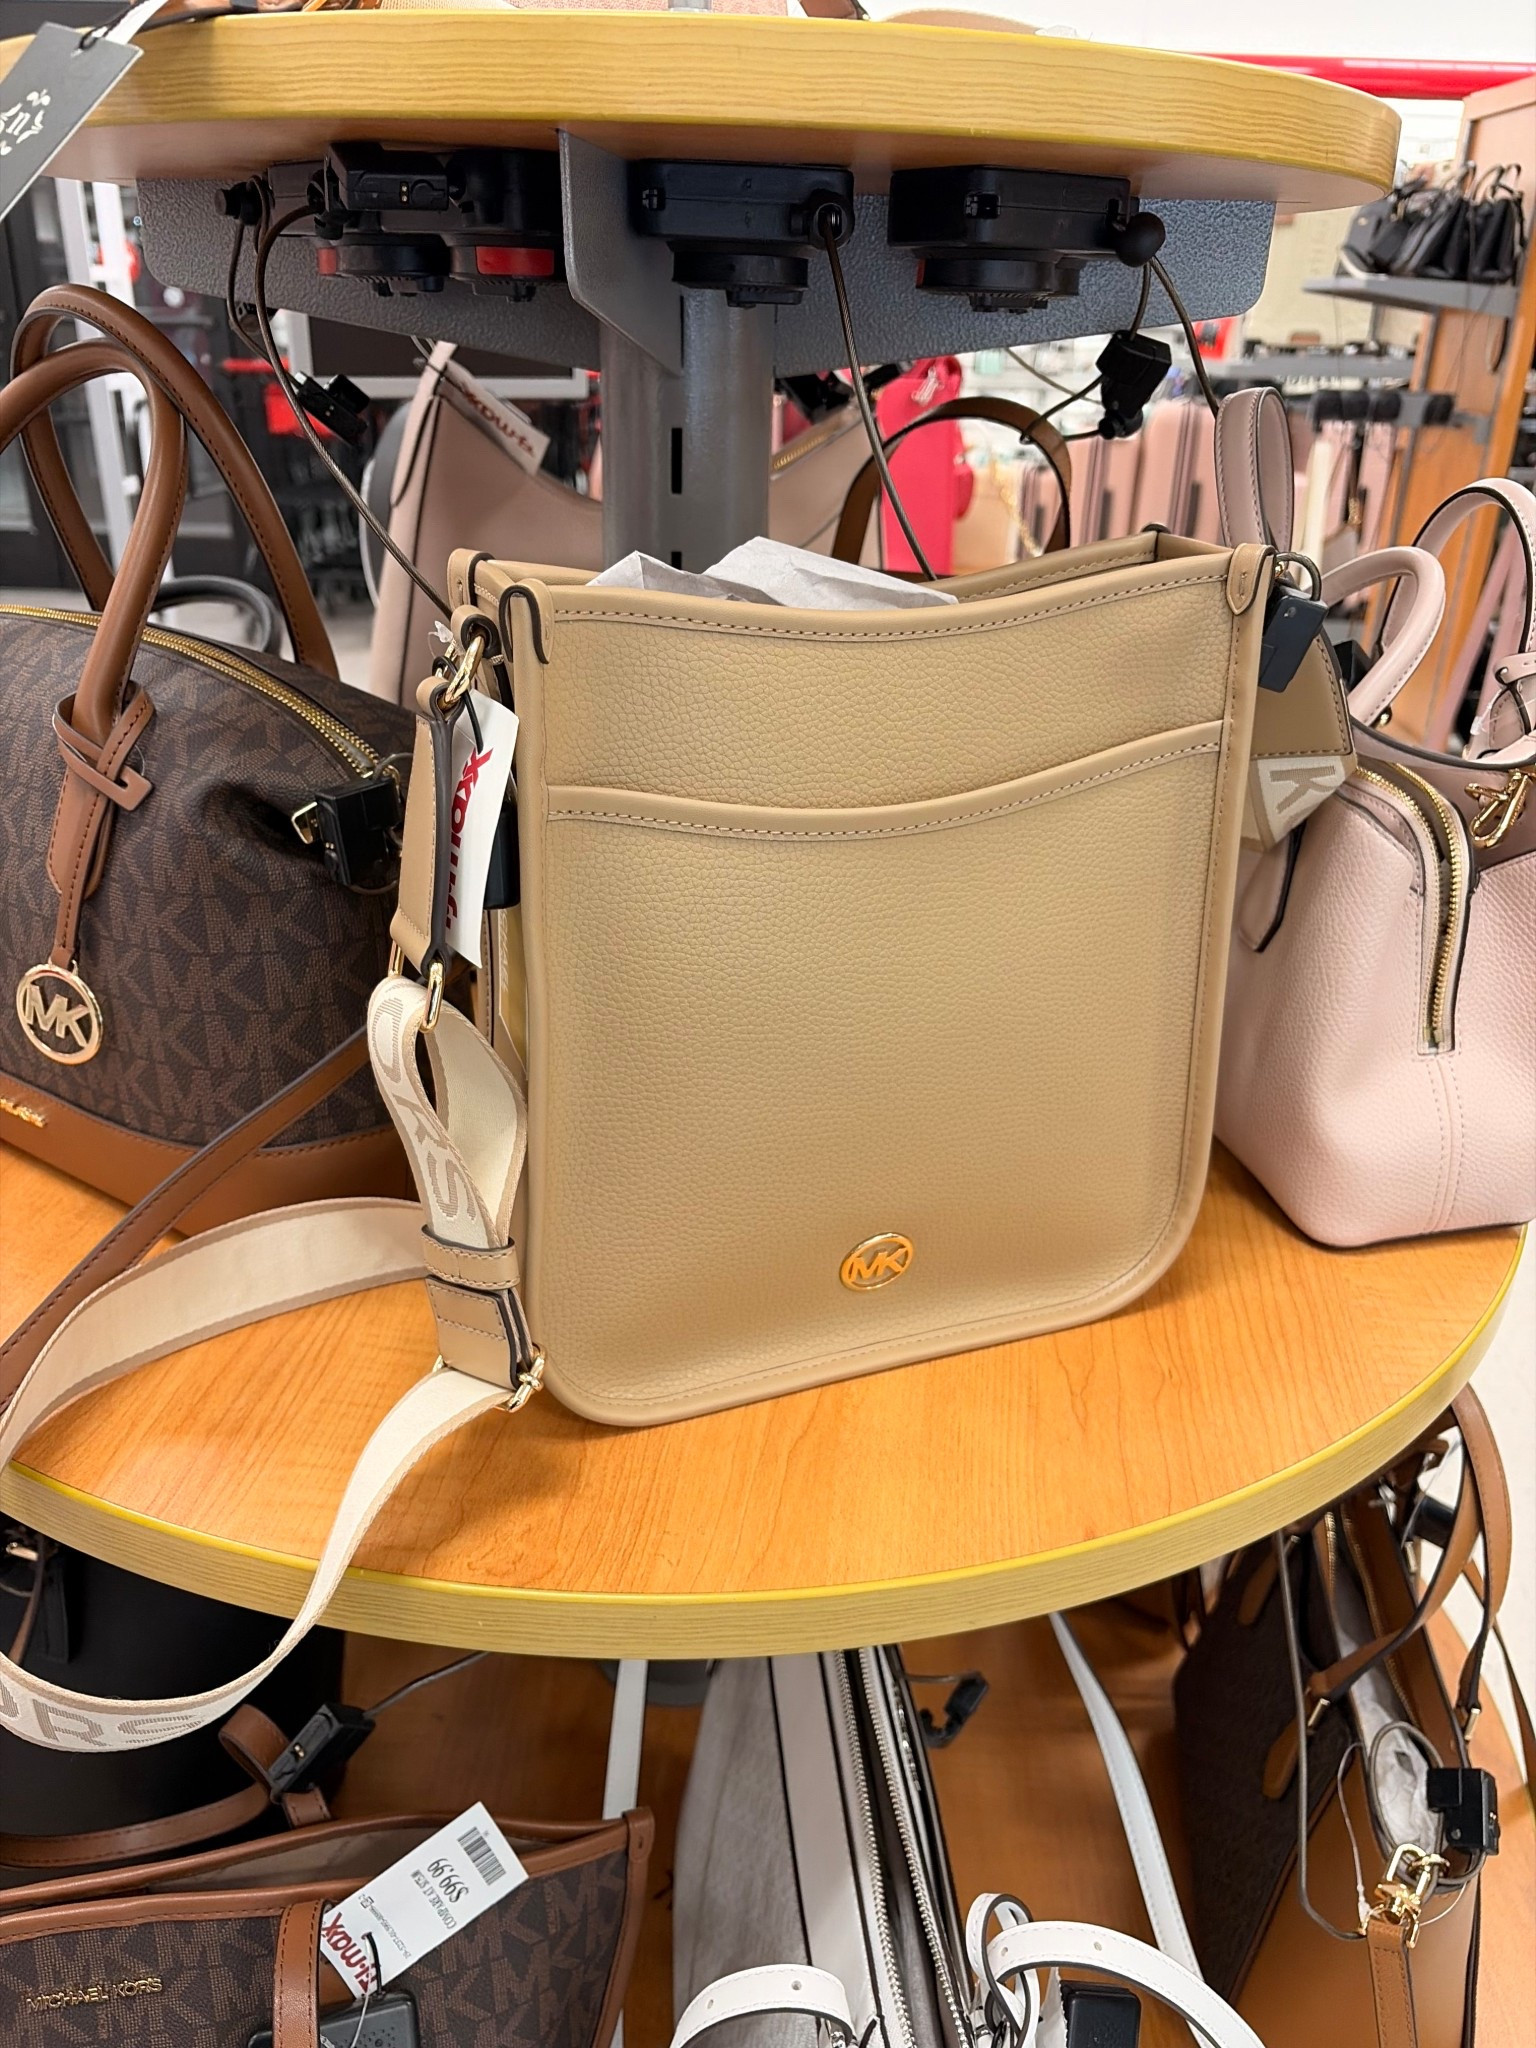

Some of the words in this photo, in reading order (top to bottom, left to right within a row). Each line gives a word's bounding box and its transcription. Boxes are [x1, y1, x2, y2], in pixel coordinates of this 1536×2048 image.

[22, 980, 94, 1050] MK
[846, 1243, 910, 1282] MK
[427, 1858, 469, 1903] $99.99
[26, 1985, 109, 2013] MICHAEL
[112, 1976, 164, 1998] KORS
